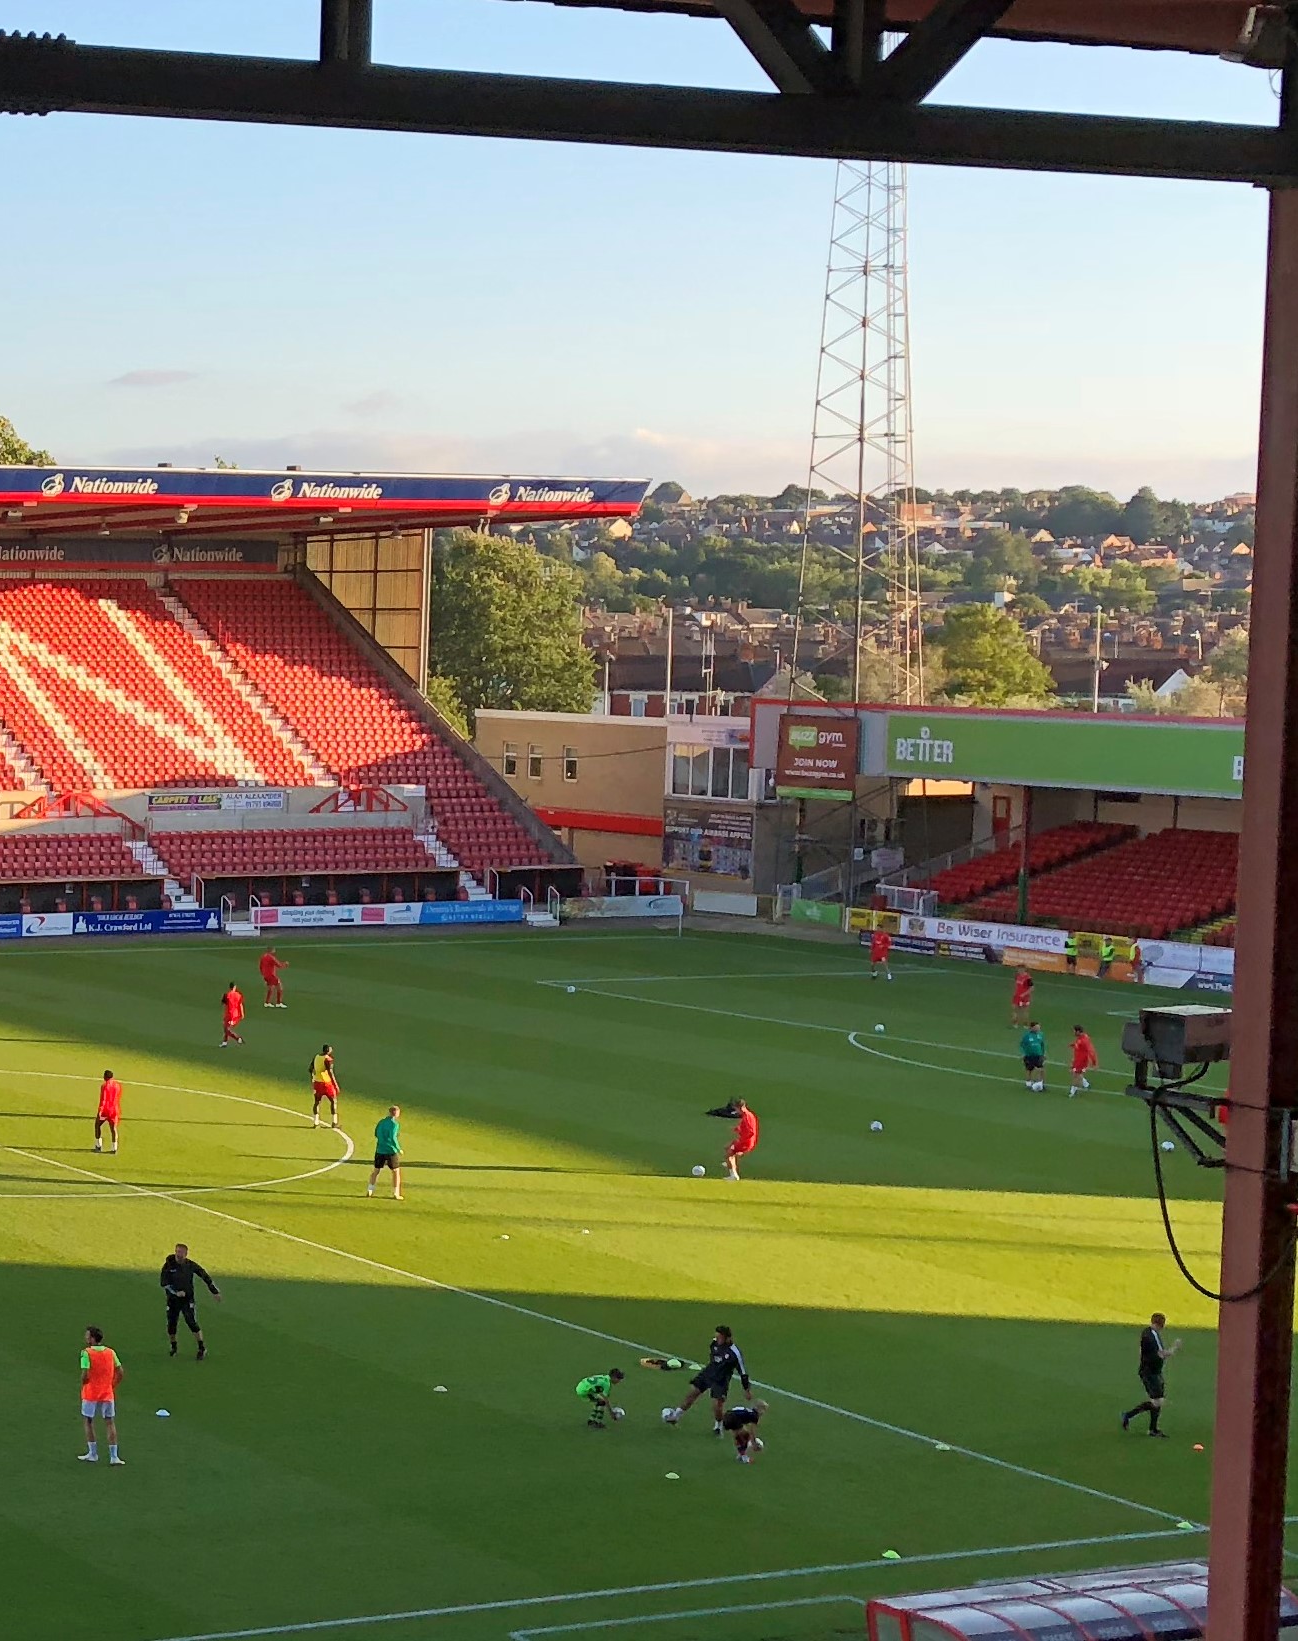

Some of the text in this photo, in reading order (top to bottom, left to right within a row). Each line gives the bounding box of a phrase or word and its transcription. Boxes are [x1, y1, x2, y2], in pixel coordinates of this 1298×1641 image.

[69, 476, 158, 496] Nationwide
[297, 481, 383, 500] Nationwide
[514, 485, 595, 503] Nationwide
[172, 545, 243, 563] Nationwide
[818, 731, 843, 743] gym
[896, 738, 953, 763] BETTER
[794, 758, 838, 768] JOIN NOW
[937, 922, 1061, 946] Be Wiser Insurance
